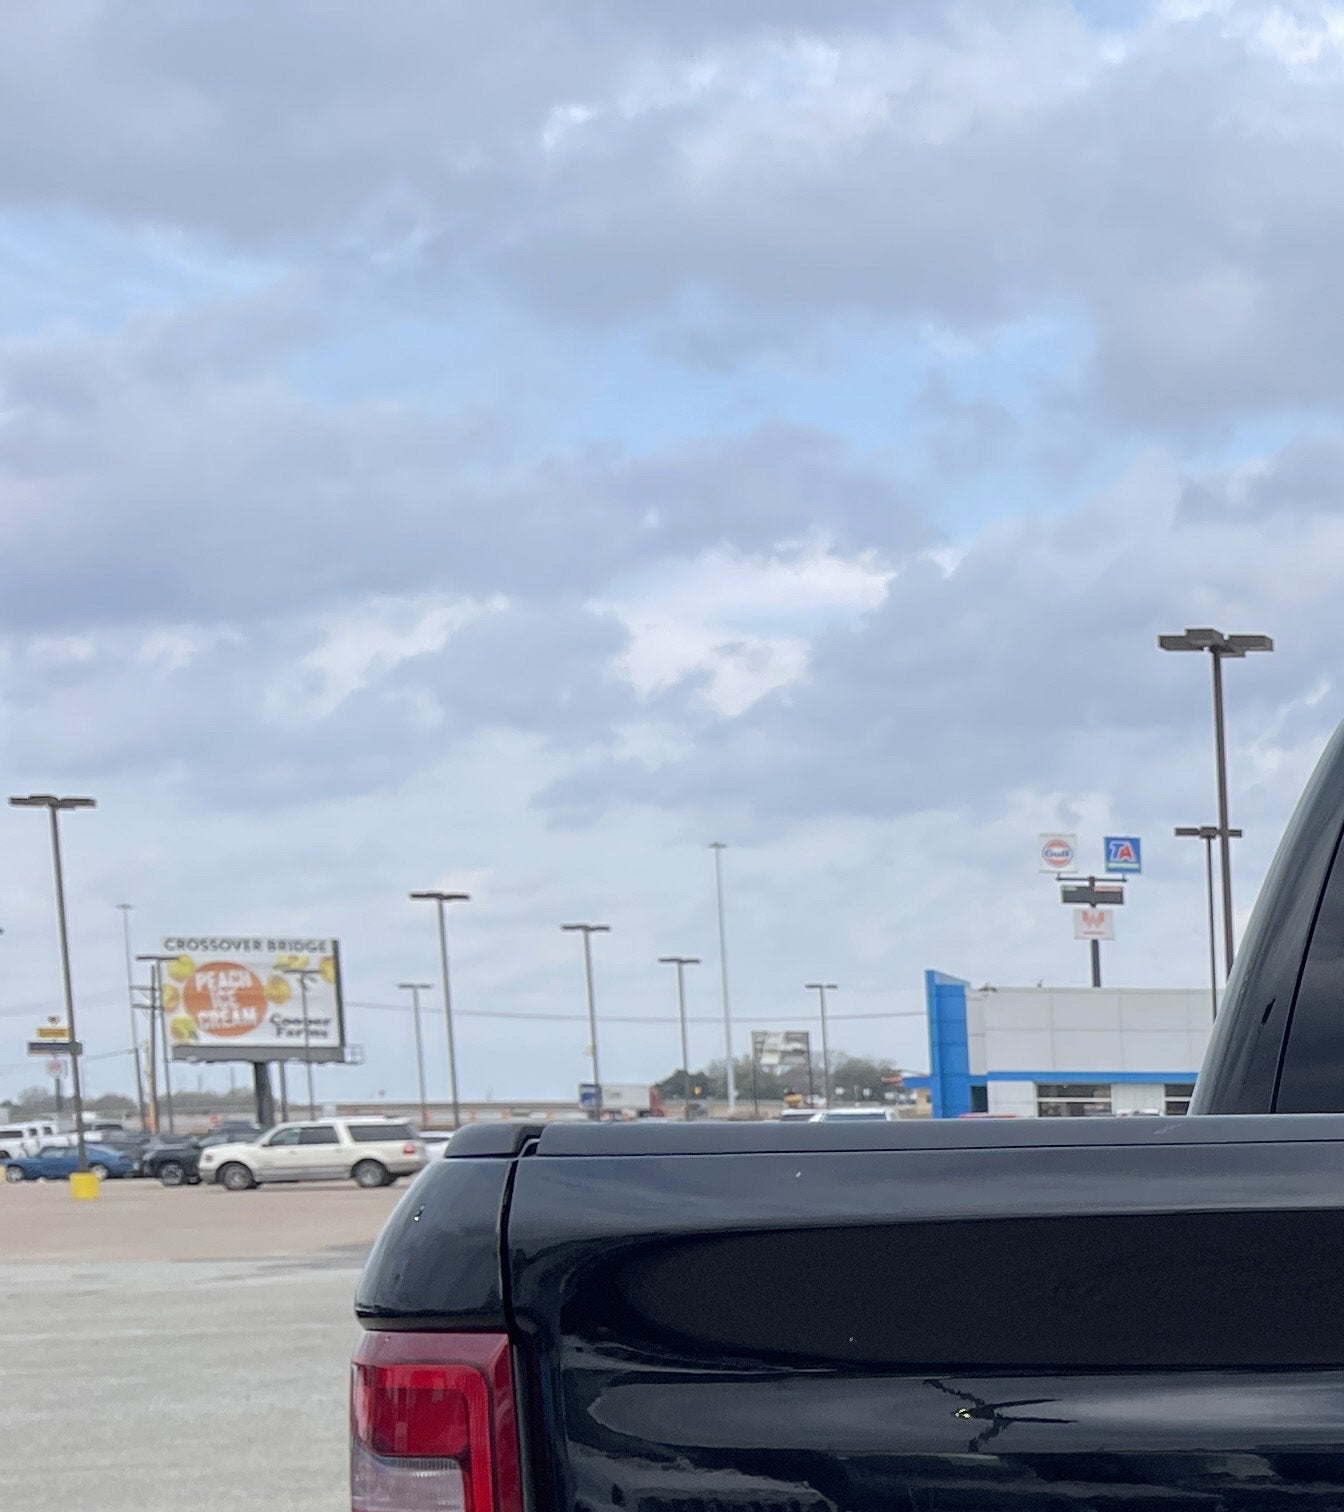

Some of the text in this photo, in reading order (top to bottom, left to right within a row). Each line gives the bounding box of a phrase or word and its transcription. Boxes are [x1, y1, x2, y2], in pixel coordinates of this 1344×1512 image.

[1109, 841, 1136, 862] TA
[164, 937, 327, 953] CROSSOVER BRIDGE
[195, 970, 253, 992] PEACH
[198, 1008, 257, 1030] CREAM
